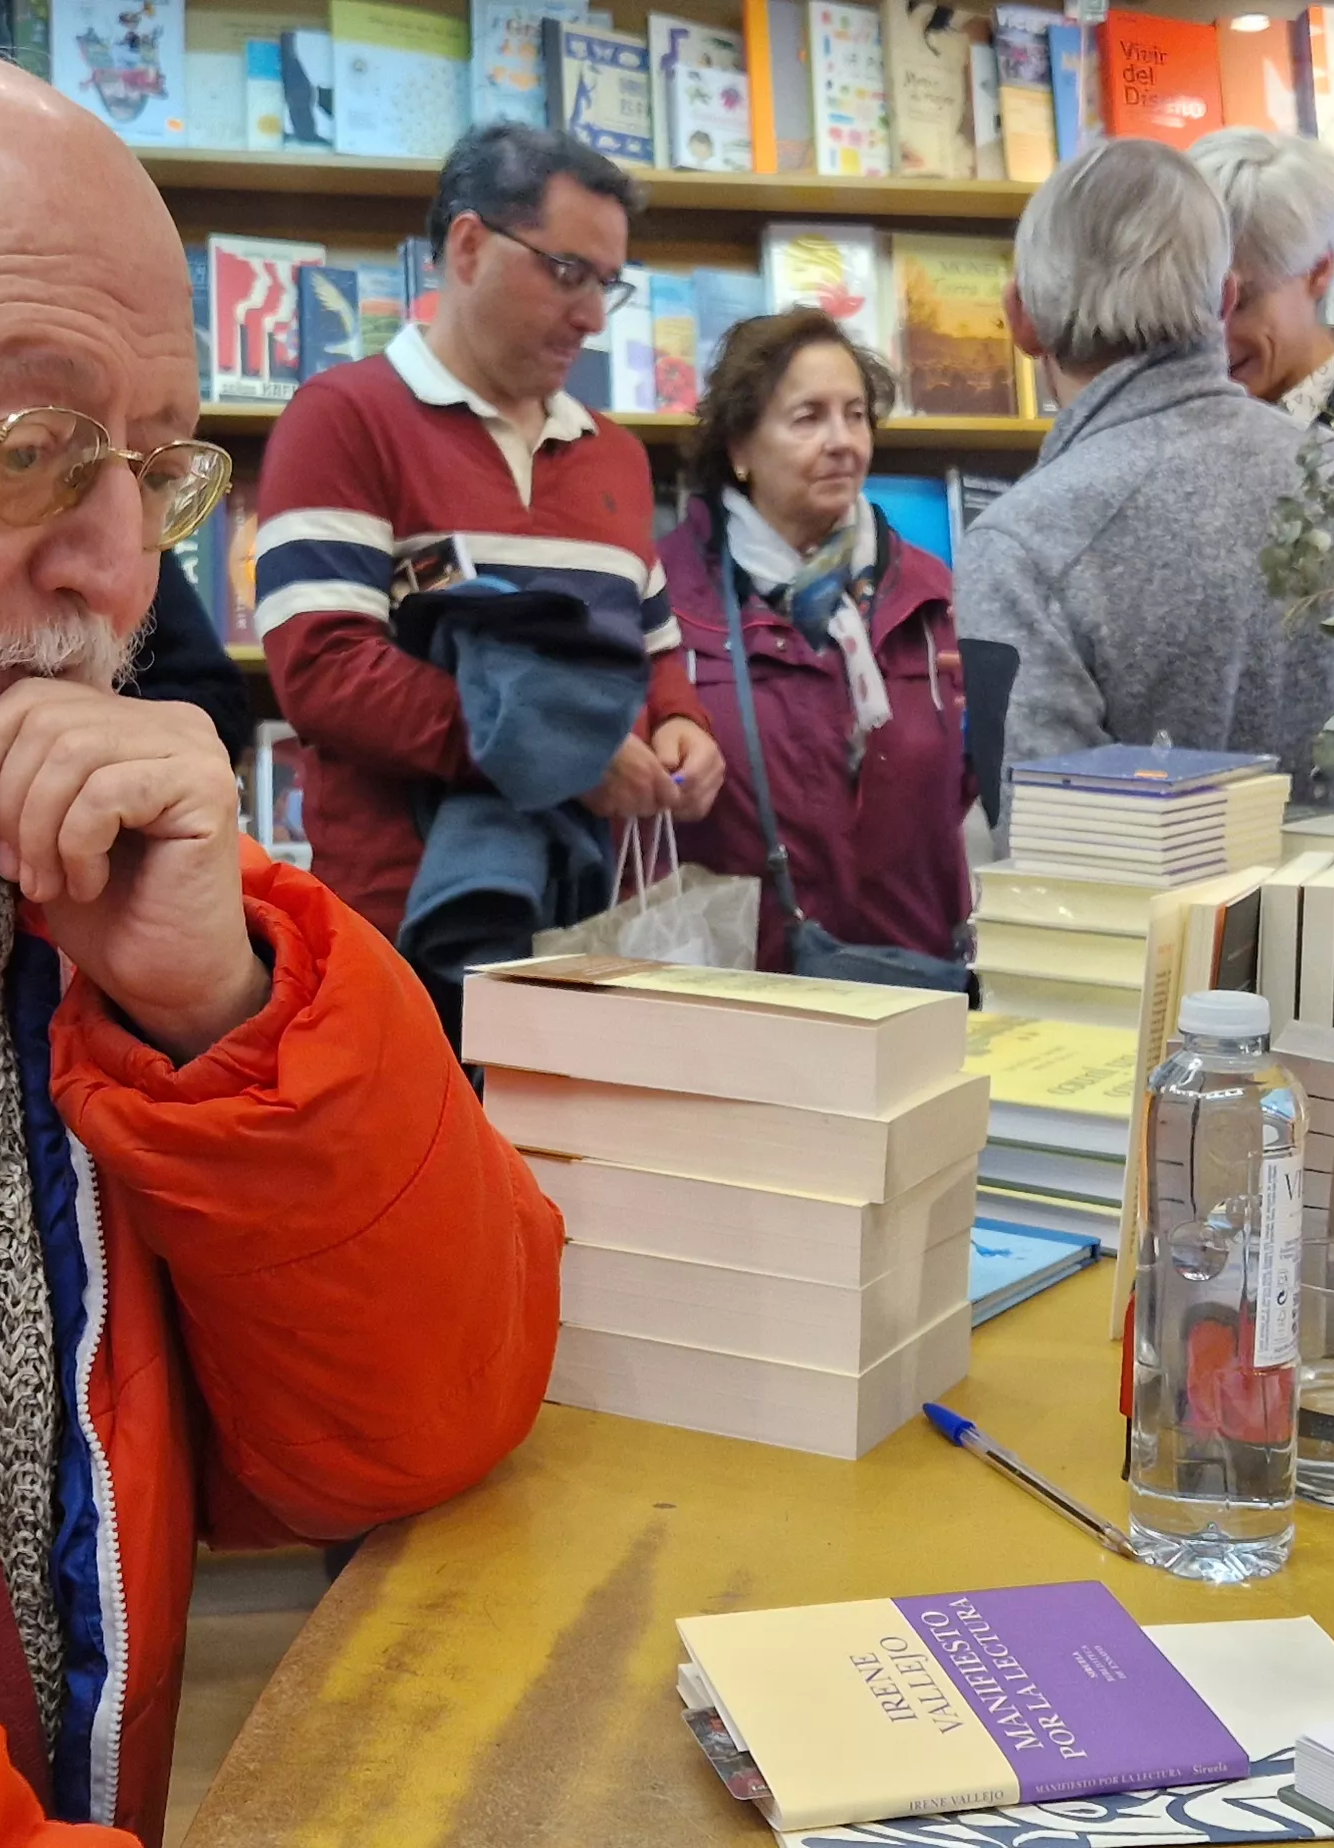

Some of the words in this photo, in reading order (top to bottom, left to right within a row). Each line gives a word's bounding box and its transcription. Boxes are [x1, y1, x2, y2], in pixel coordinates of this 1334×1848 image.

[1119, 40, 1168, 65] Vivir
[1123, 64, 1155, 86] del
[948, 1597, 1029, 1681] LECTURA
[850, 1652, 919, 1723] IRENE
[880, 1636, 965, 1735] VALLEJO
[920, 1611, 1045, 1752] MANIFIESTO
[1017, 1683, 1052, 1712] LA
[1038, 1713, 1088, 1760] POR
[1034, 1778, 1097, 1795] MANIFIESTO
[1098, 1775, 1120, 1787] POR
[1120, 1773, 1135, 1784] LA
[1136, 1767, 1183, 1783] LECTURA
[1192, 1762, 1228, 1777] Siruela
[908, 1799, 948, 1811] IRENE
[951, 1789, 1005, 1808] VALLEJO
